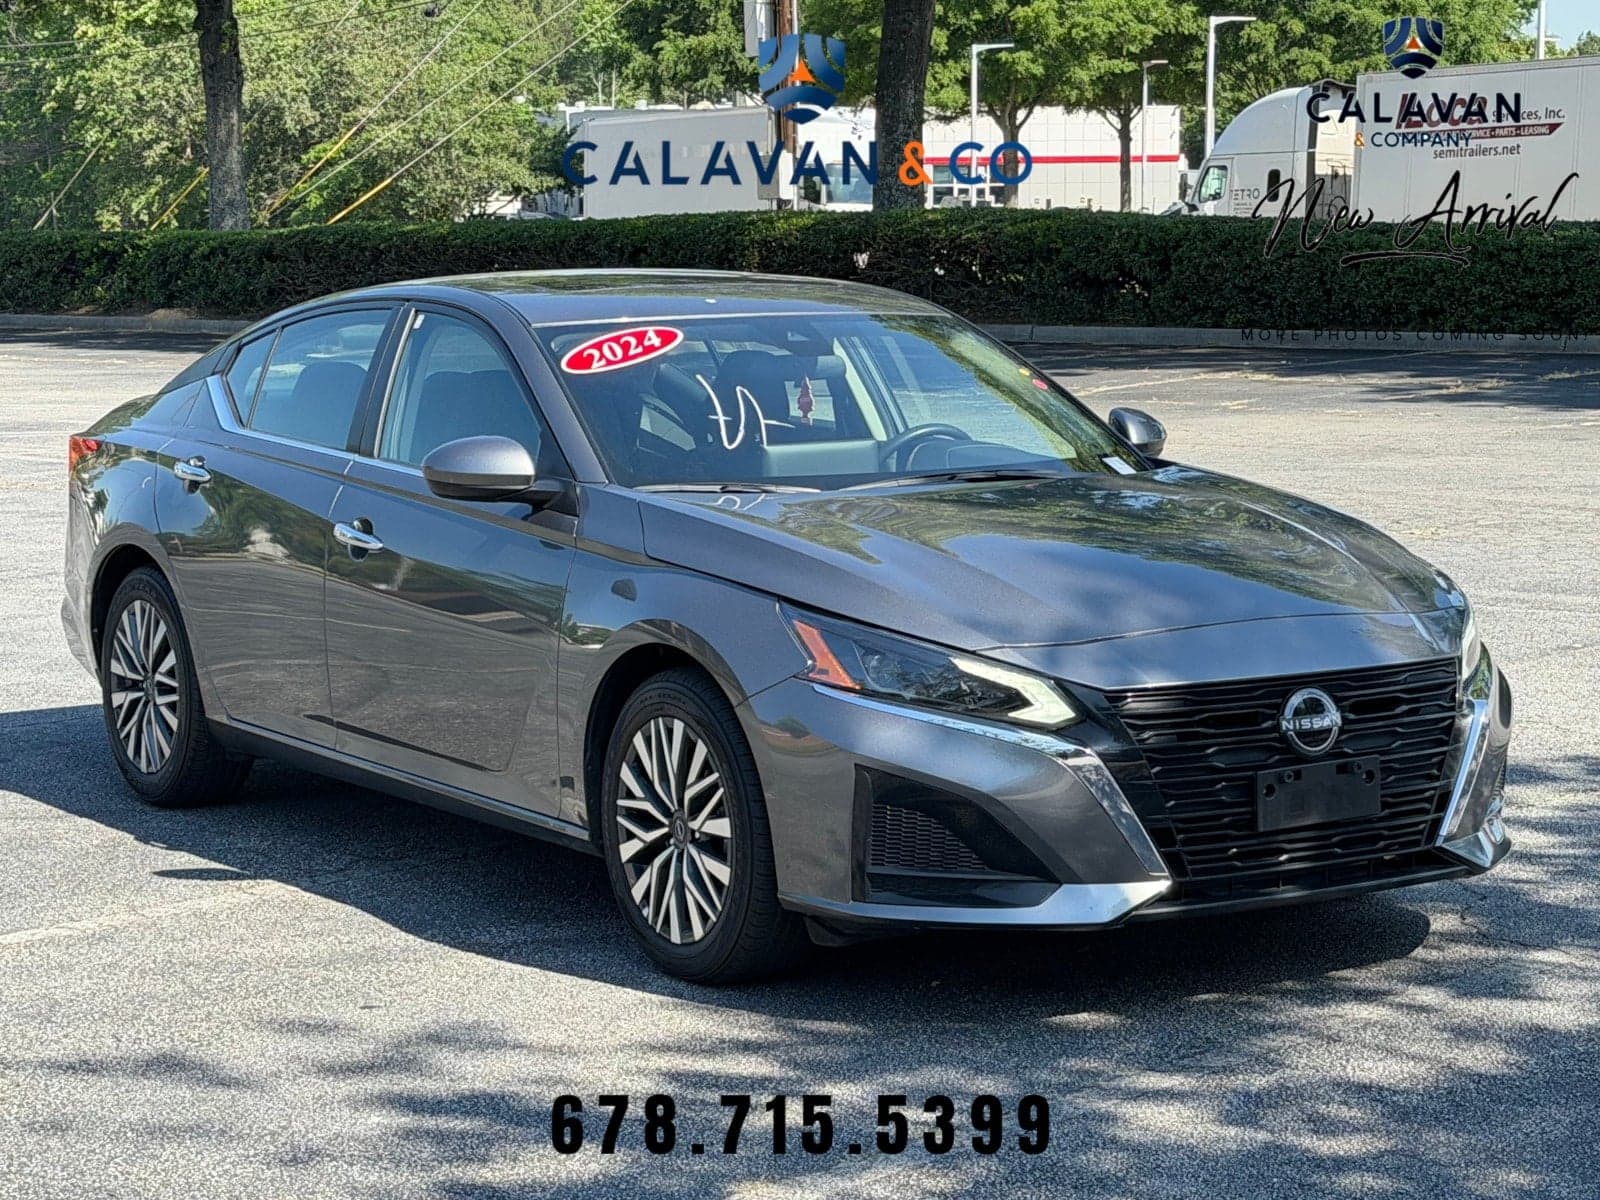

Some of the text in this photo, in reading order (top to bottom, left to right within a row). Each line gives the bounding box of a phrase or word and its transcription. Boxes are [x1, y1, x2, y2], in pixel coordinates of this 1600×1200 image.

[1545, 107, 1565, 119] Inc.
[1495, 127, 1516, 137] PARTS
[1521, 125, 1550, 135] LEASING
[1432, 143, 1521, 159] semitrailers.net
[583, 329, 662, 369] 2024
[1281, 711, 1342, 731] NISSAN
